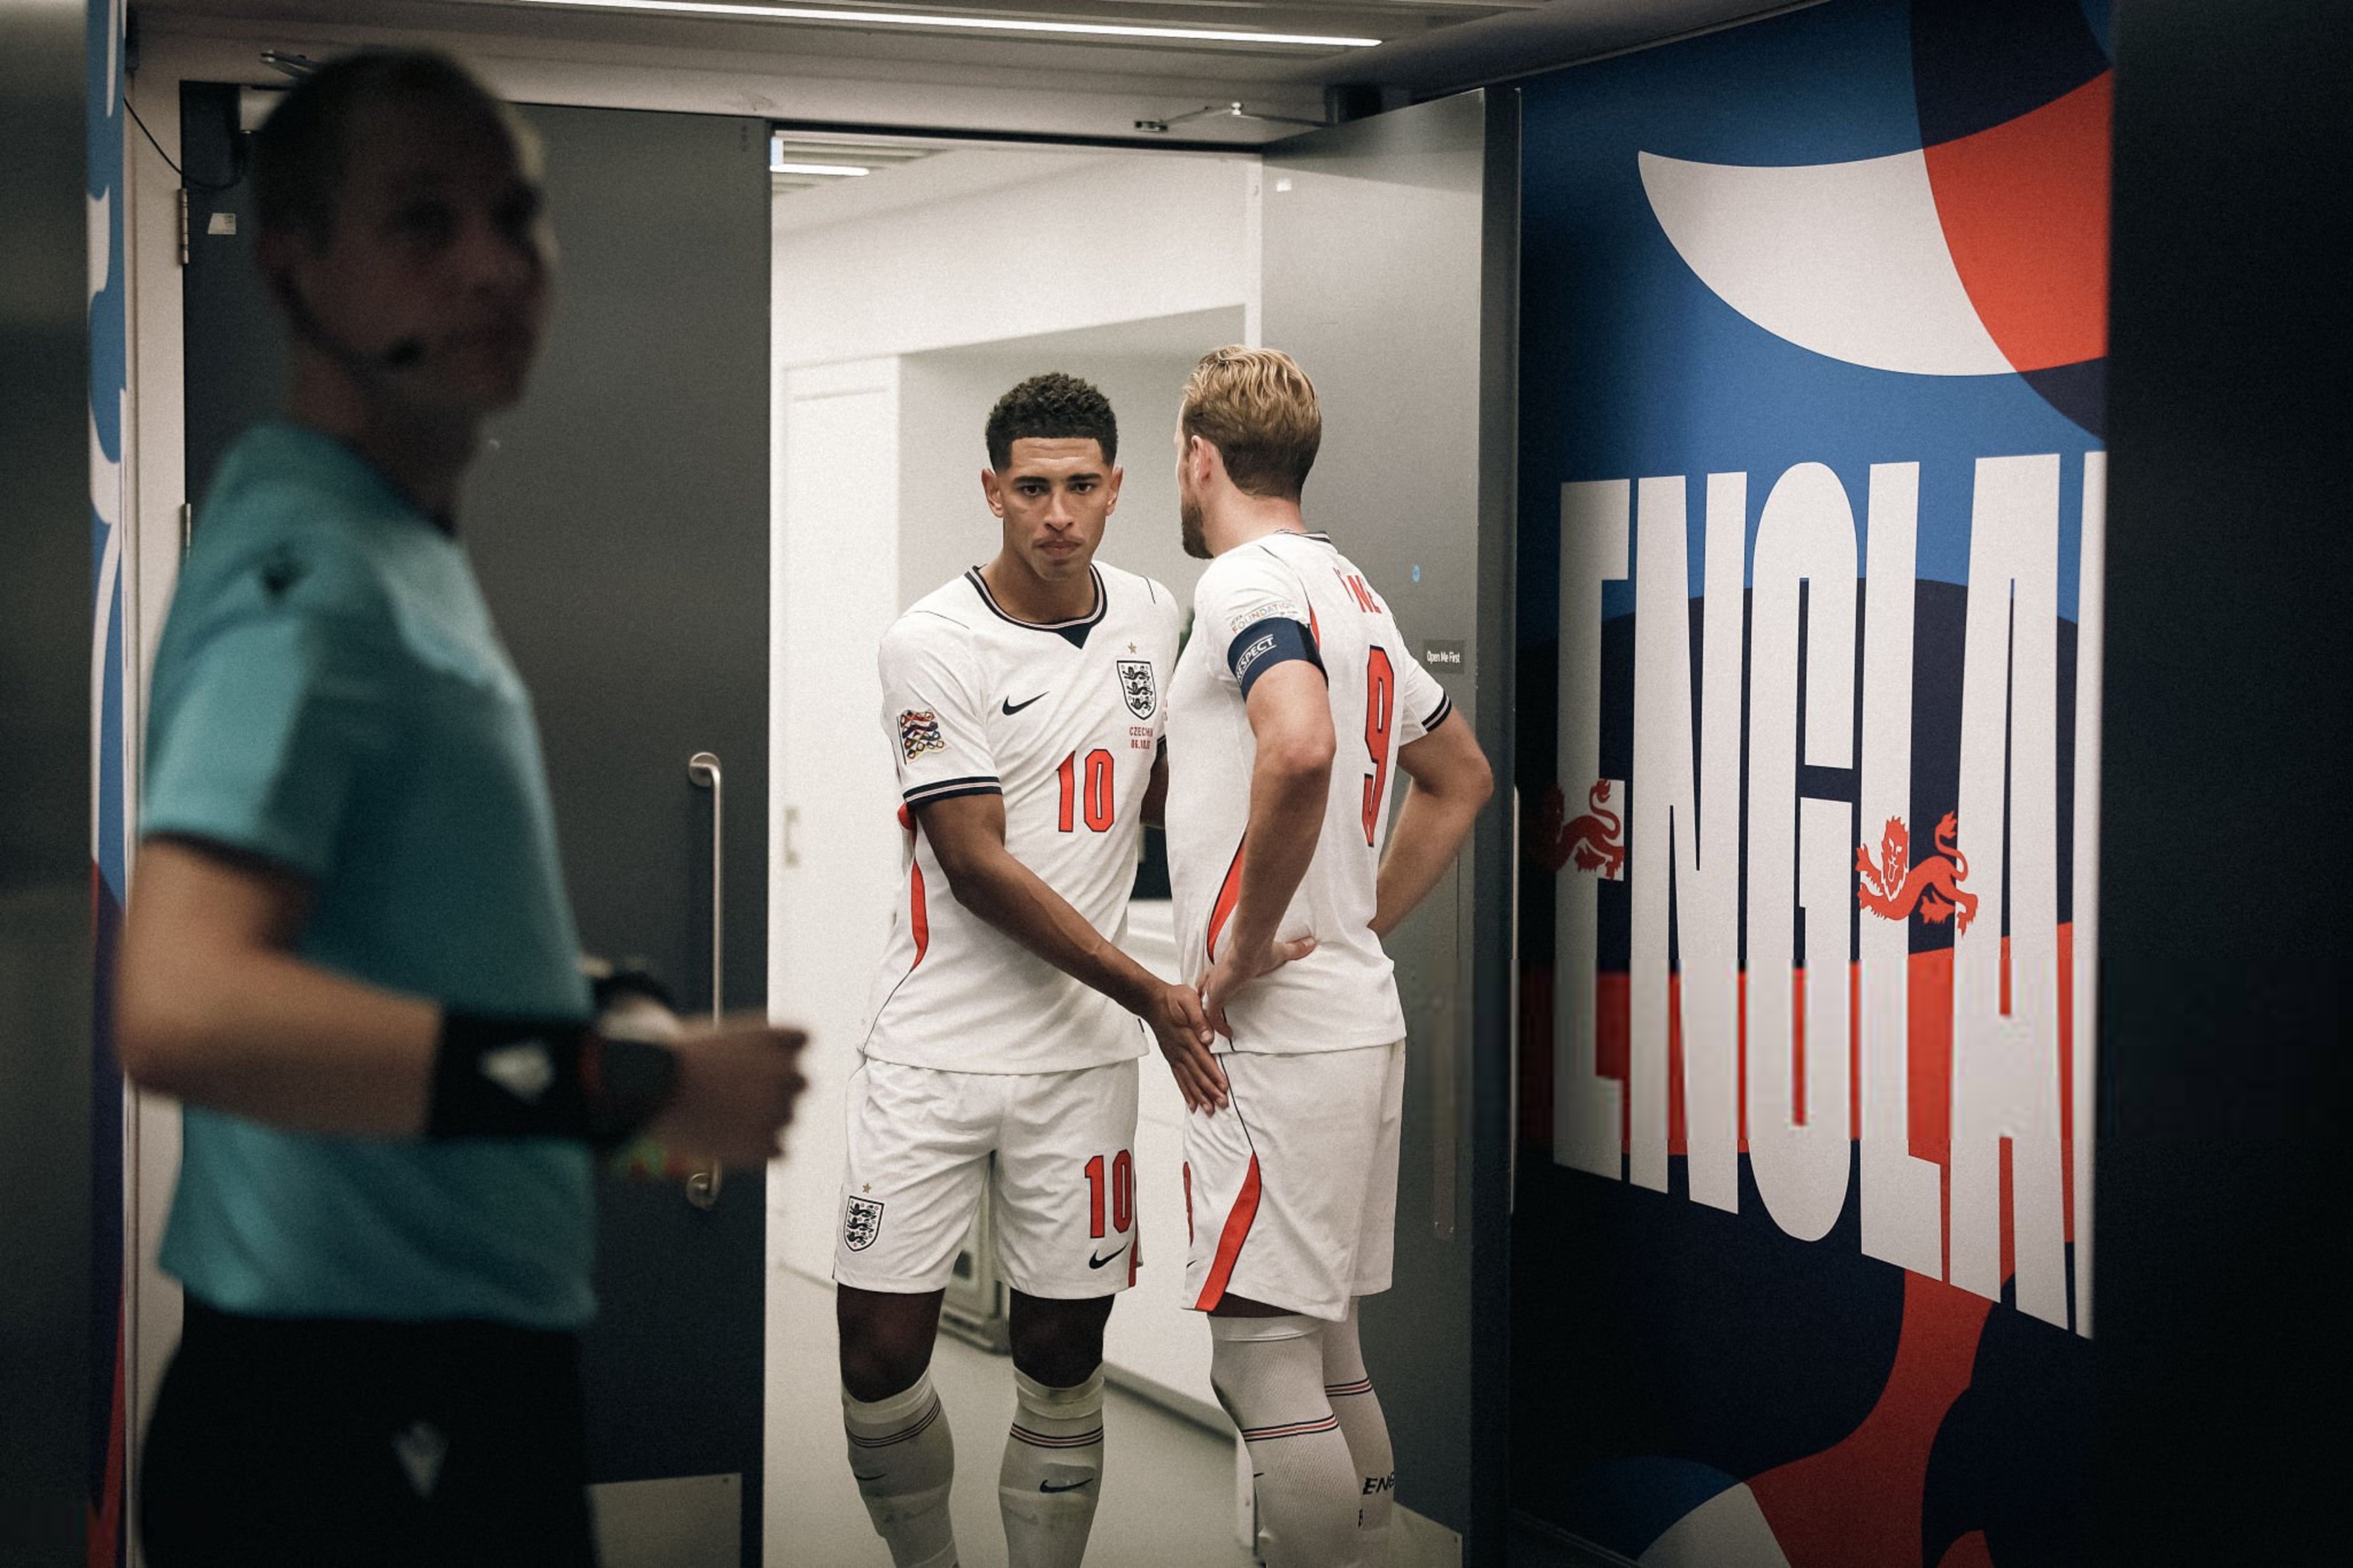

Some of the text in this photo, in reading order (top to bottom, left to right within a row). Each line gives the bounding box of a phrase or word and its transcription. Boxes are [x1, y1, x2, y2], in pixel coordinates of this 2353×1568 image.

[1426, 650, 1460, 665] Open Me First
[1361, 644, 1394, 847] 9
[1058, 748, 1114, 833] 10
[1084, 1149, 1132, 1238] 10
